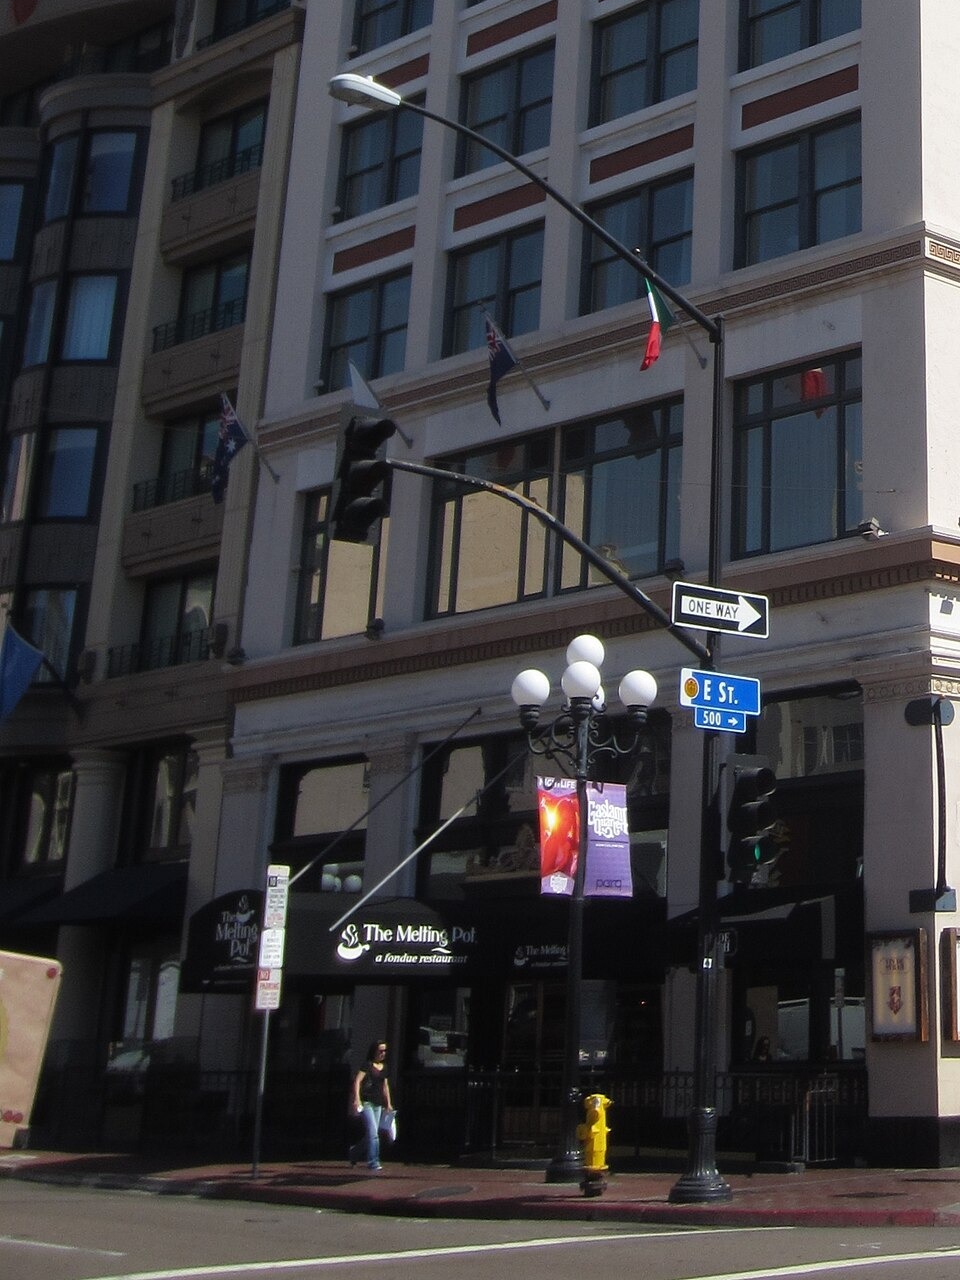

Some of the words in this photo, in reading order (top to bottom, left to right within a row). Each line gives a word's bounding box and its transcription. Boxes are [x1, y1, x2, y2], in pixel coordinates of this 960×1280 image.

[689, 599, 712, 615] ONE
[715, 603, 739, 619] WAY
[703, 679, 712, 701] E
[703, 710, 722, 726] 500
[215, 922, 258, 944] Melting
[363, 923, 393, 943] The
[396, 924, 449, 948] Melting
[230, 939, 251, 958] Pot
[375, 954, 383, 963] a
[384, 952, 418, 964] fondue
[418, 953, 468, 965] restaurant
